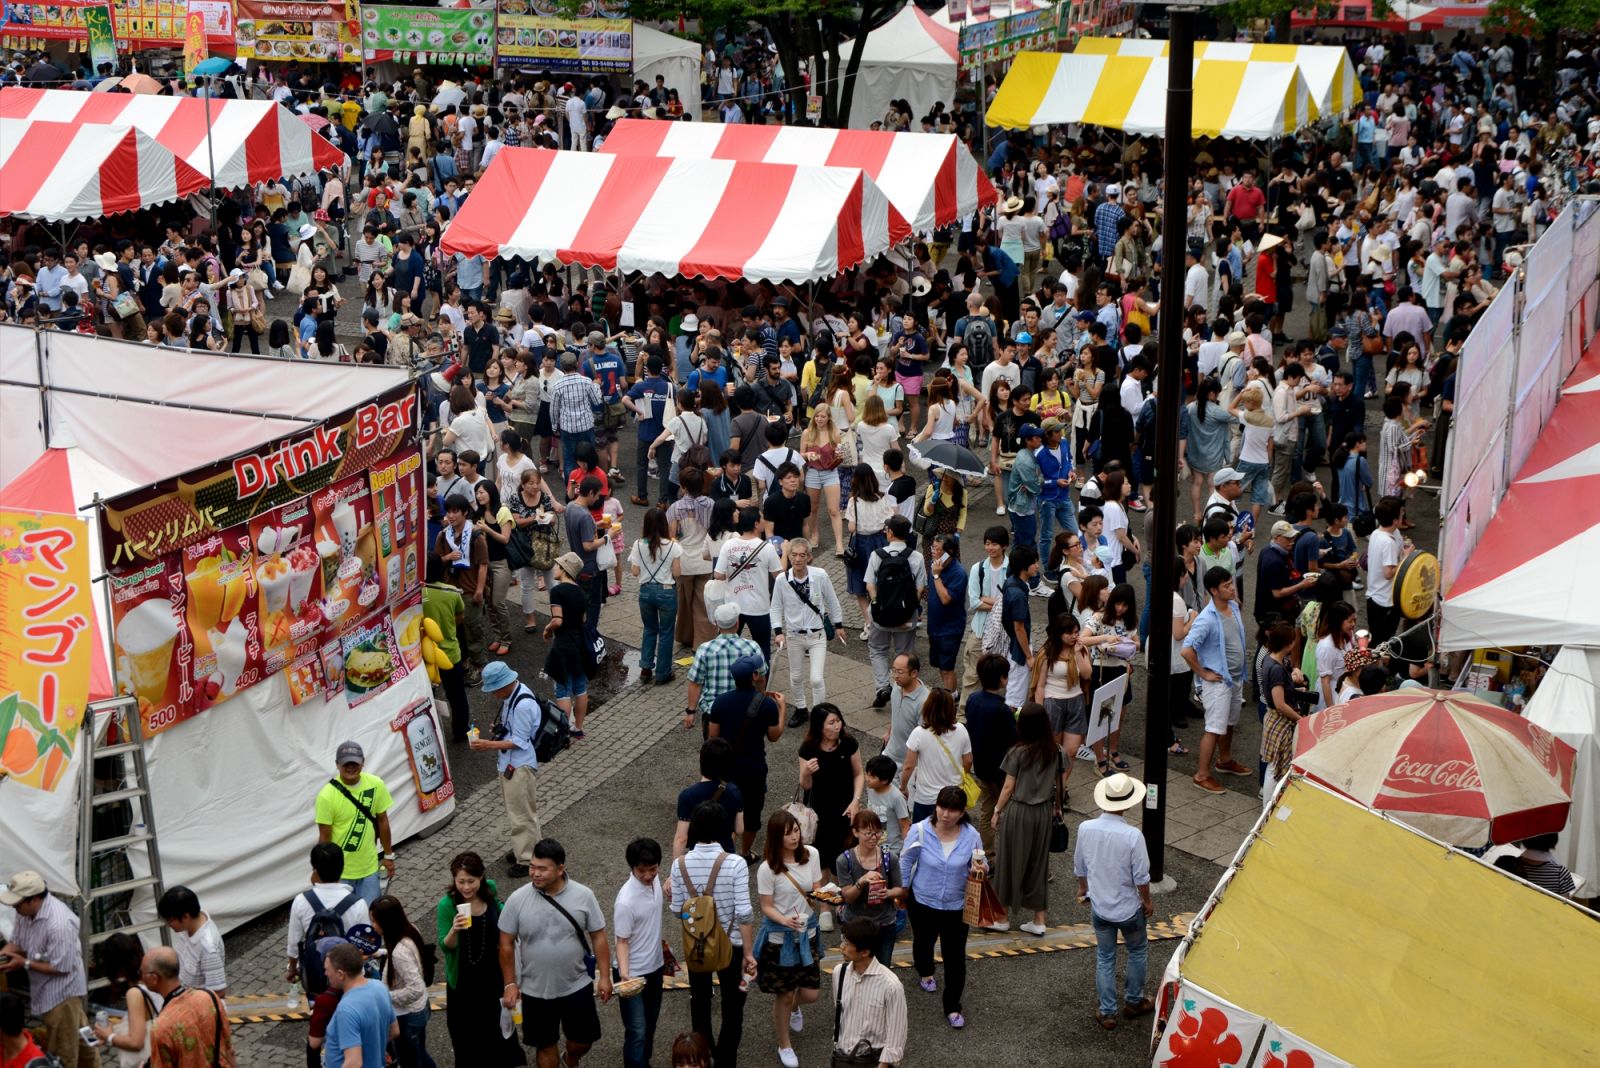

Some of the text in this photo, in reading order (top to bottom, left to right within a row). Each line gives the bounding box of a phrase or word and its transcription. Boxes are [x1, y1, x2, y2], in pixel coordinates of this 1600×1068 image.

[232, 394, 416, 499] Drink Bar
[370, 464, 396, 494] Beer
[143, 562, 165, 580] beer
[23, 528, 87, 726] マンゴー
[340, 613, 360, 632] 400
[295, 637, 317, 659] 400
[235, 668, 258, 688] 400
[391, 666, 407, 684] 500
[150, 704, 176, 731] 500
[1394, 754, 1482, 790] Coca-Cola
[436, 781, 453, 801] 500
